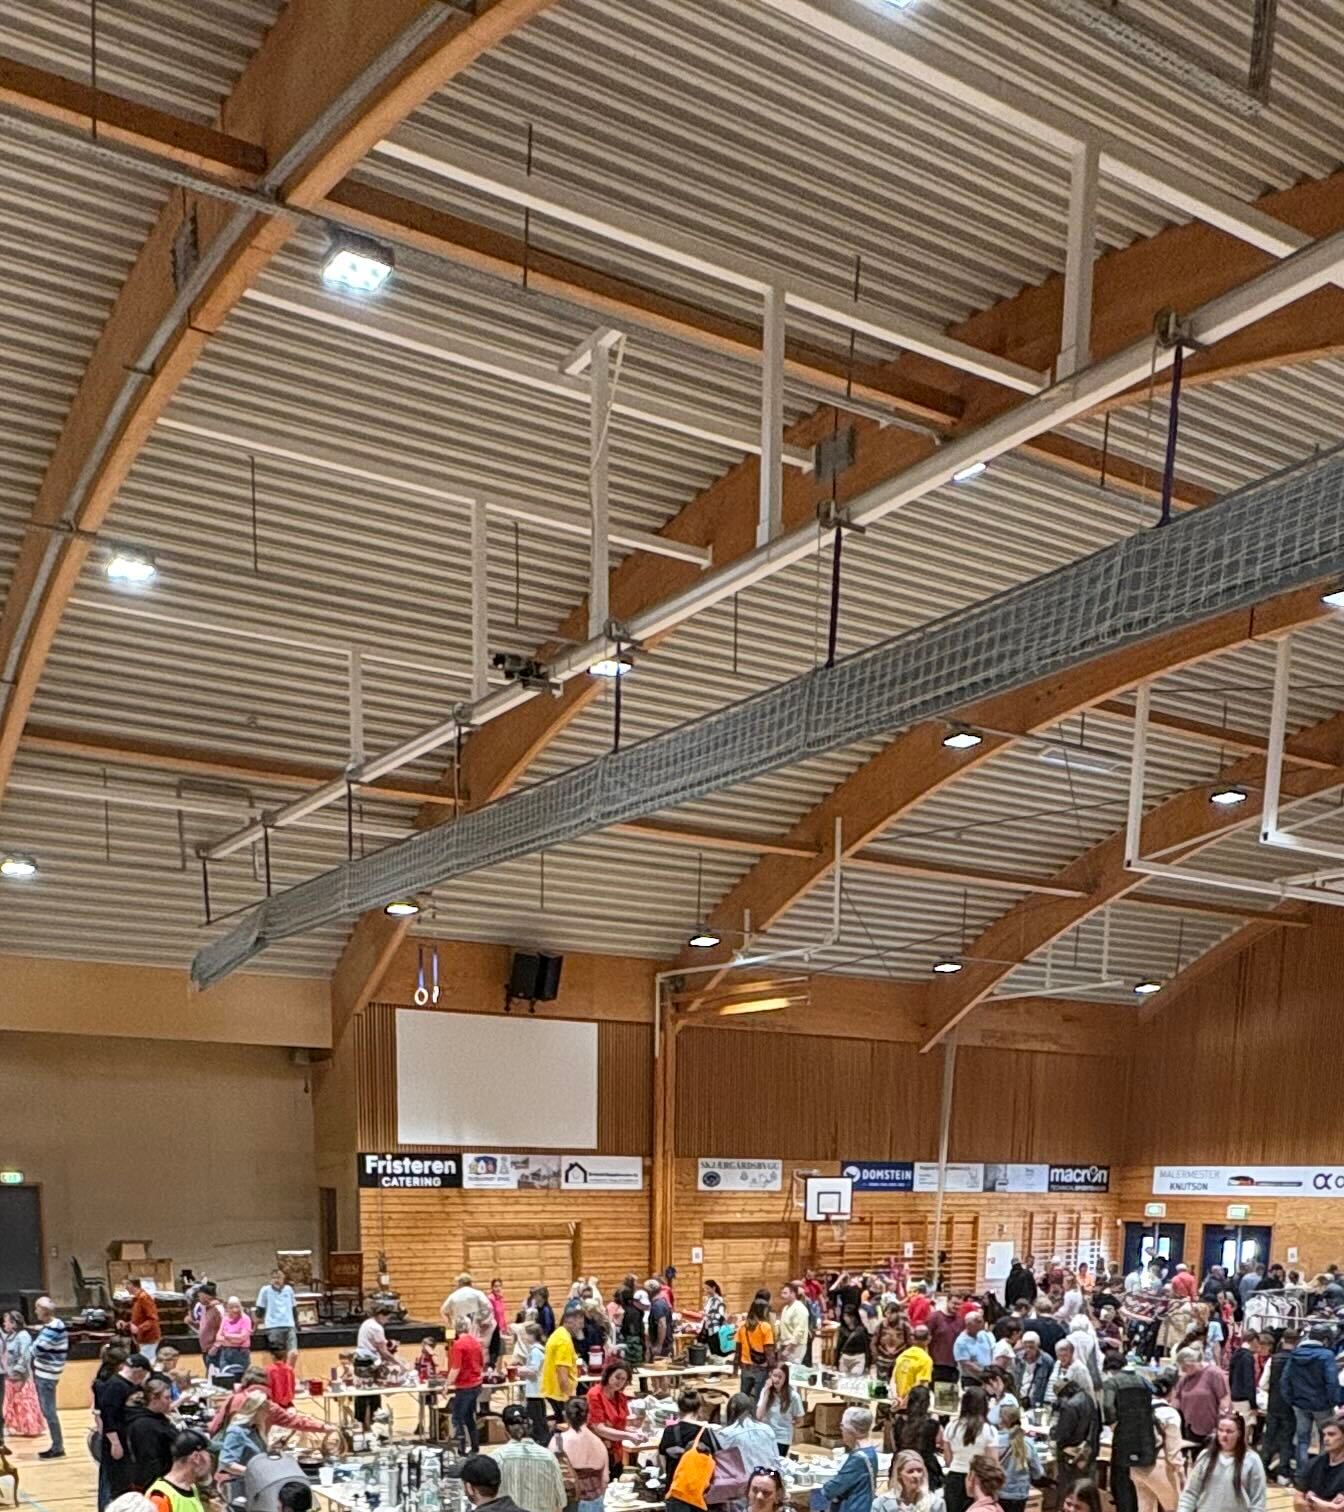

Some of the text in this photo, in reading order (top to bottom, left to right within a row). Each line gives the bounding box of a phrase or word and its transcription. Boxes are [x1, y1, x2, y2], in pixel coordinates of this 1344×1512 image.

[365, 1154, 456, 1174] Fristeren
[862, 1169, 912, 1180] DOMSTEIN
[1050, 1165, 1108, 1183] macron
[1160, 1169, 1220, 1179] MALERMESTER
[381, 1176, 442, 1187] CATERING
[1169, 1182, 1208, 1191] KNUTSON
